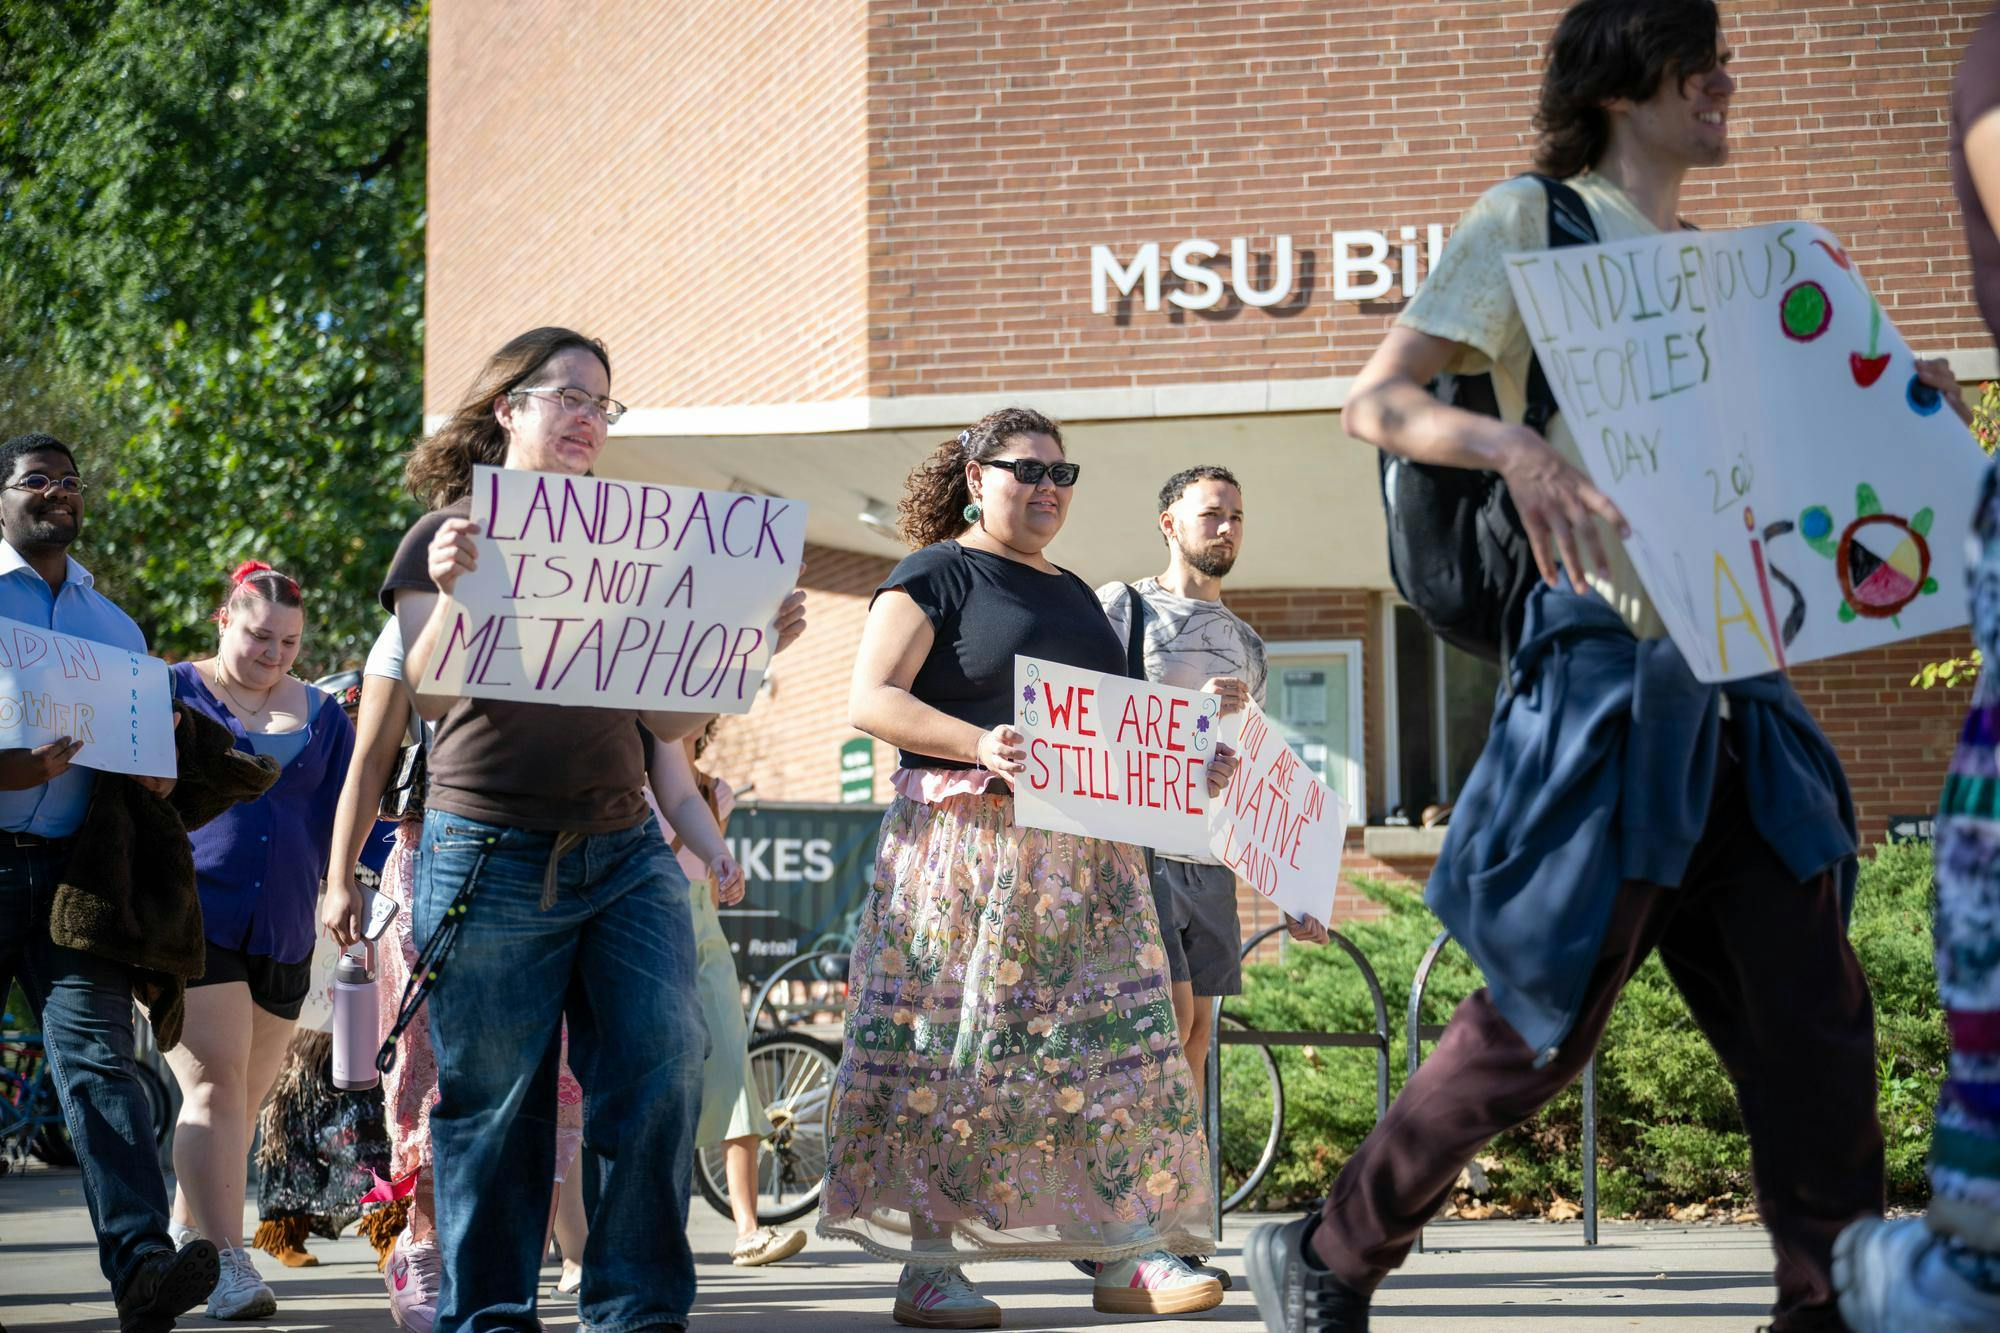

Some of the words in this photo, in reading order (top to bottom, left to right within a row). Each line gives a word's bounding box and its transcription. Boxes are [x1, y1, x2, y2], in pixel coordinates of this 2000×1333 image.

[1091, 234, 1293, 314] MSU
[1602, 426, 1662, 483] DAY
[486, 472, 789, 565] LANDBACK
[502, 553, 573, 600] IS
[583, 557, 663, 607] NOT
[664, 565, 694, 609] A
[434, 612, 763, 700] METAPHOR
[0, 690, 95, 744] OWER
[1043, 682, 1097, 737] WE
[1116, 694, 1189, 752] ARE
[1030, 737, 1119, 801] STILL
[1126, 750, 1205, 816] HERE
[1239, 709, 1268, 763] YOU
[1268, 748, 1299, 796] ARE
[1303, 780, 1325, 823] ON
[1223, 756, 1310, 871] NATIVE
[1223, 824, 1278, 897] LAND
